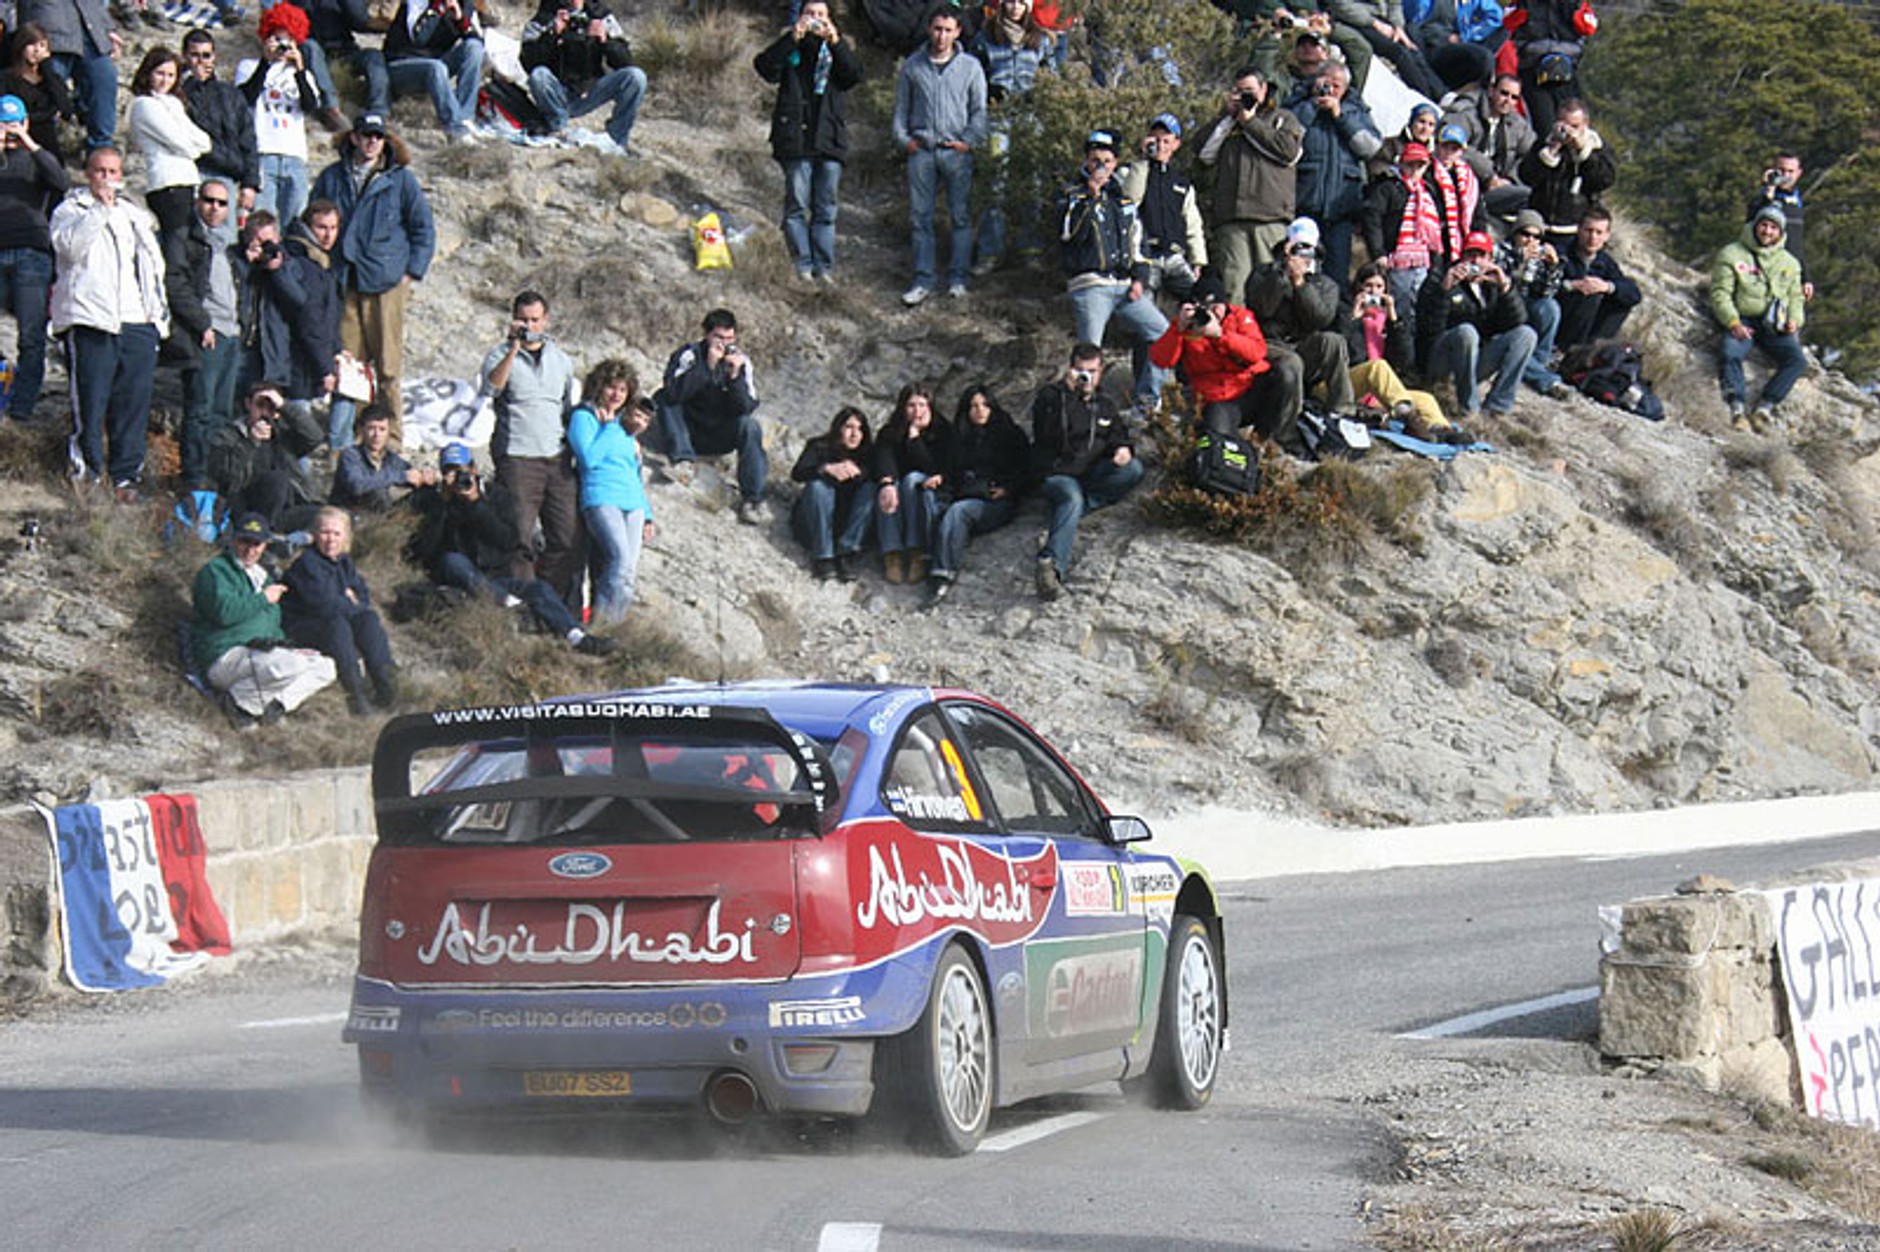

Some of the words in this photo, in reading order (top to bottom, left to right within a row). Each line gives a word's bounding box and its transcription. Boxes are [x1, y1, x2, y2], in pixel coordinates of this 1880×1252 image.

[433, 703, 711, 724] WWW.VISITABUDHABI.AE
[479, 1009, 521, 1028] Feel
[525, 1009, 557, 1027] the
[561, 1009, 667, 1028] difference
[769, 996, 866, 1028] PIRELLI
